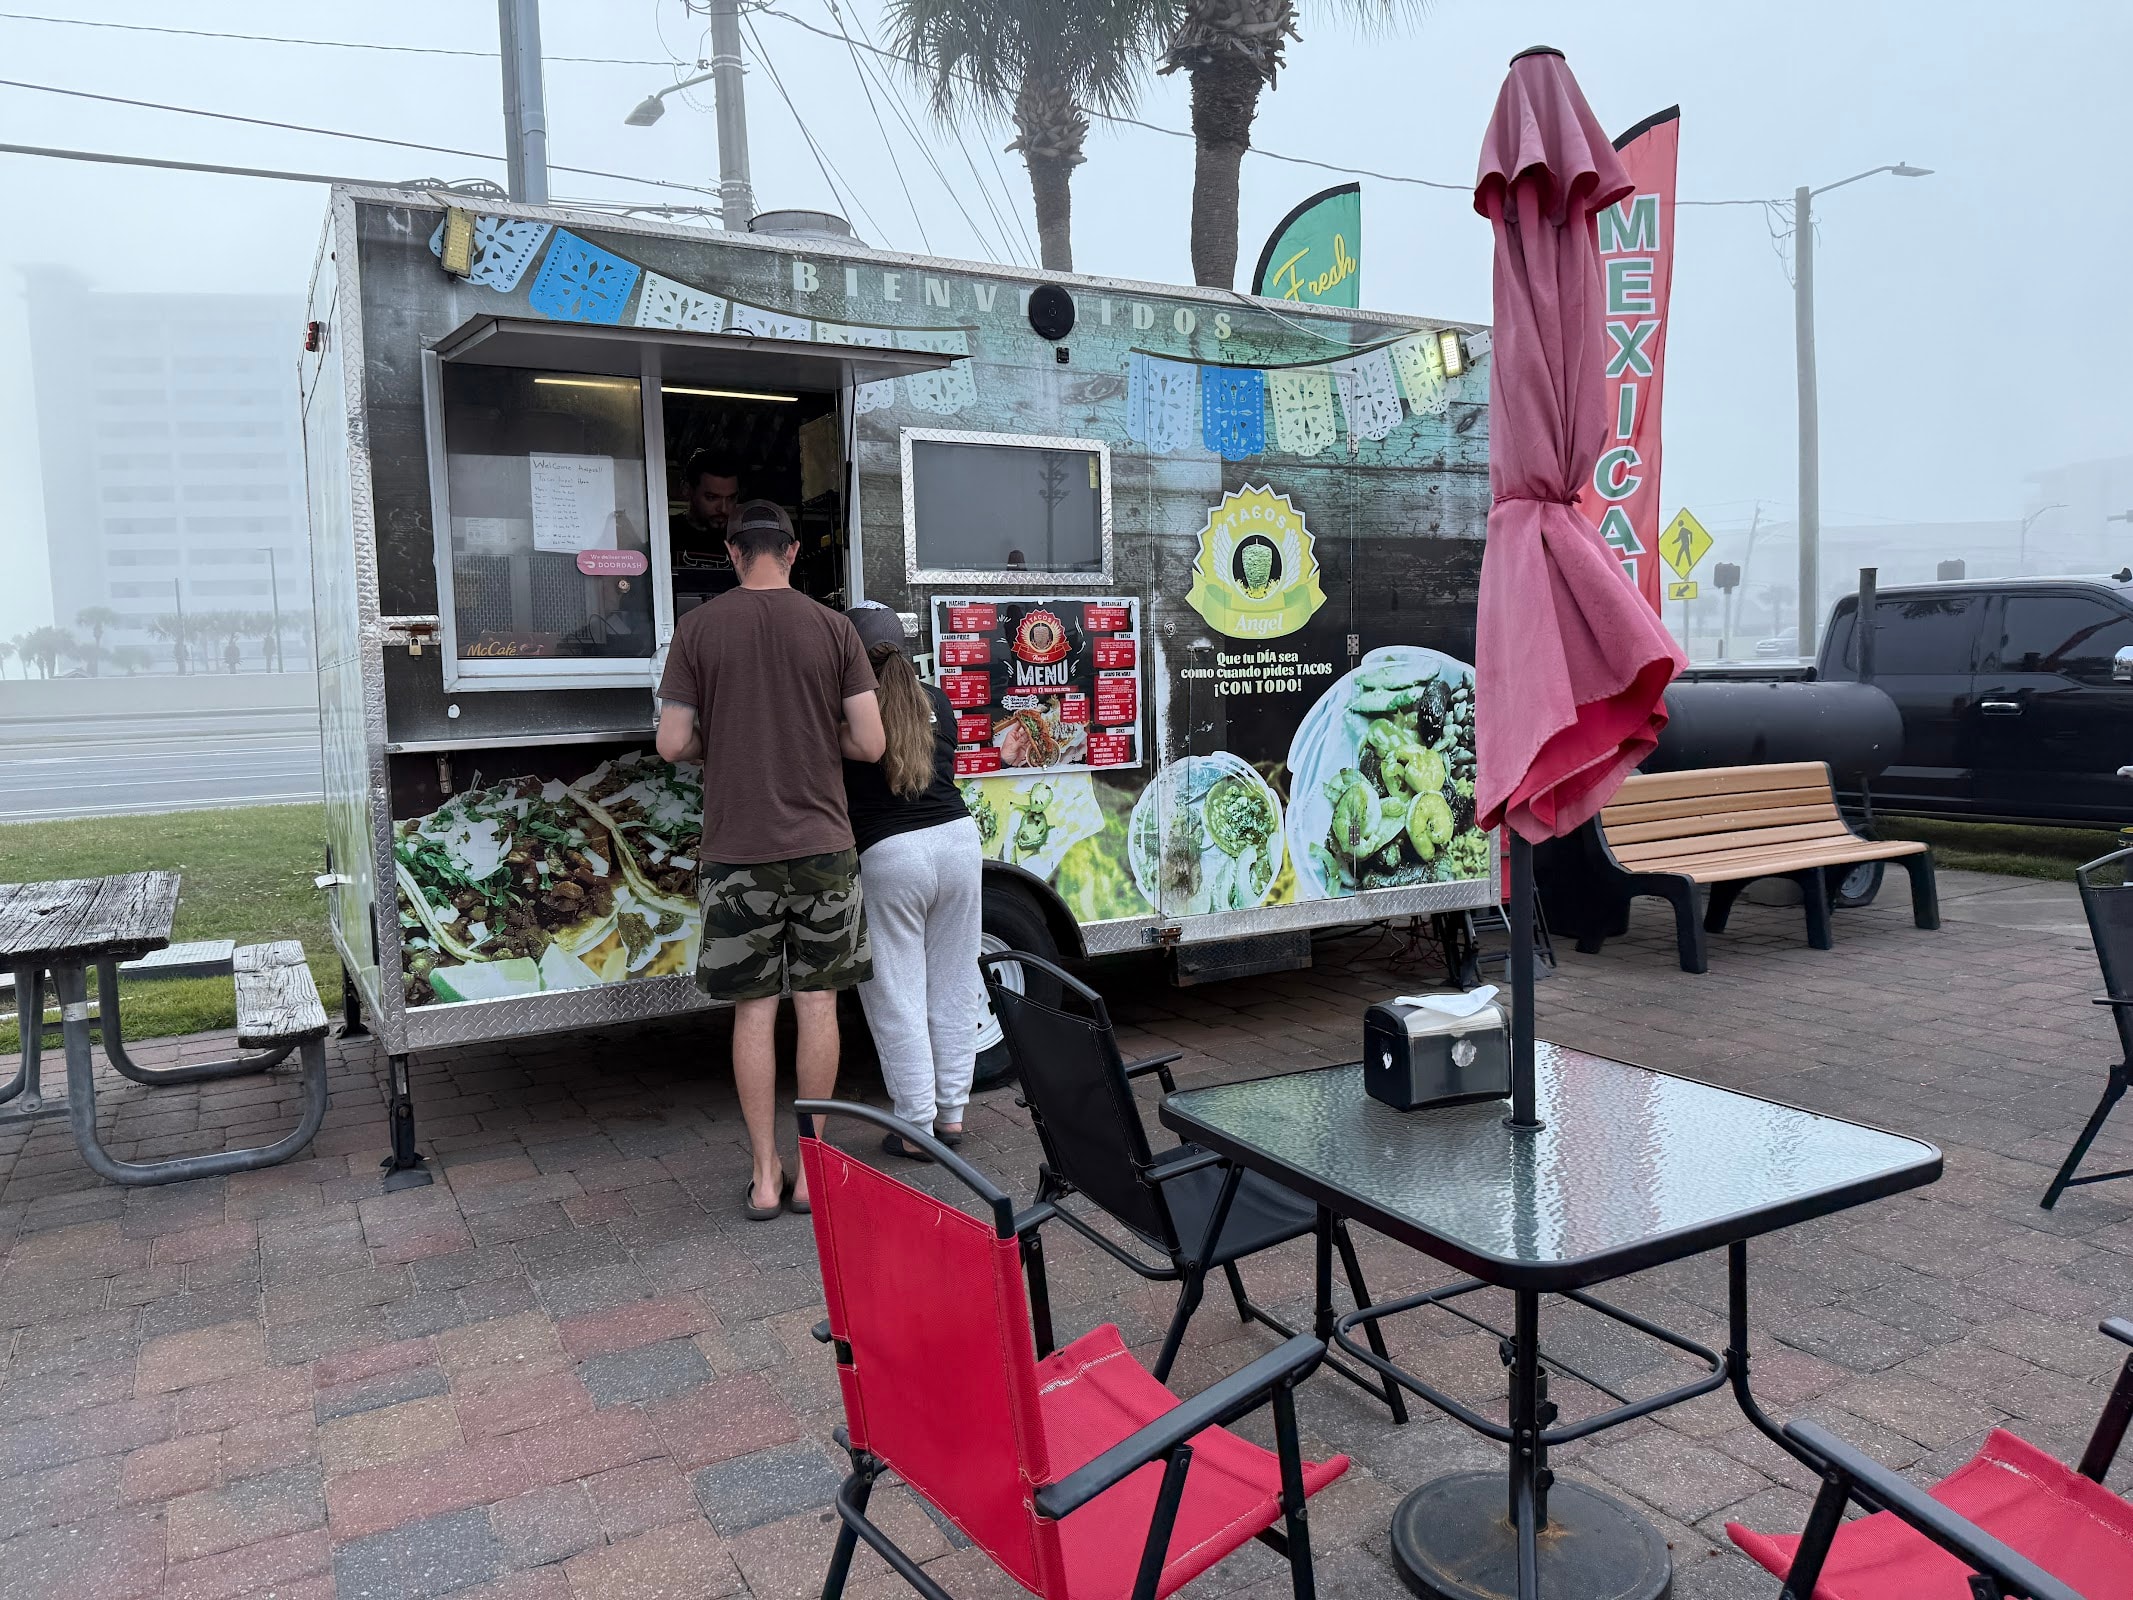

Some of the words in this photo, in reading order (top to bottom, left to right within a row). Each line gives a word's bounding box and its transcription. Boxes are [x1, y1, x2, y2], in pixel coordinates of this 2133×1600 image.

[1272, 233, 1357, 303] Fresh
[1593, 193, 1662, 589] MEXICA
[1226, 505, 1287, 529] TACOS
[1029, 614, 1052, 624] TACOS
[1234, 614, 1284, 635] Angel
[467, 641, 517, 657] McCafé
[1216, 652, 1240, 665] Que
[1242, 652, 1255, 664] tu
[1256, 649, 1276, 663] DÍA
[1278, 651, 1299, 663] sea
[1016, 659, 1069, 687] MENU
[1180, 668, 1213, 679] como
[1216, 665, 1261, 679] cuando
[1263, 664, 1295, 680] pides
[1296, 662, 1333, 676] TACOS
[1213, 681, 1252, 698] ¡CON
[1255, 678, 1303, 694] TODO!
